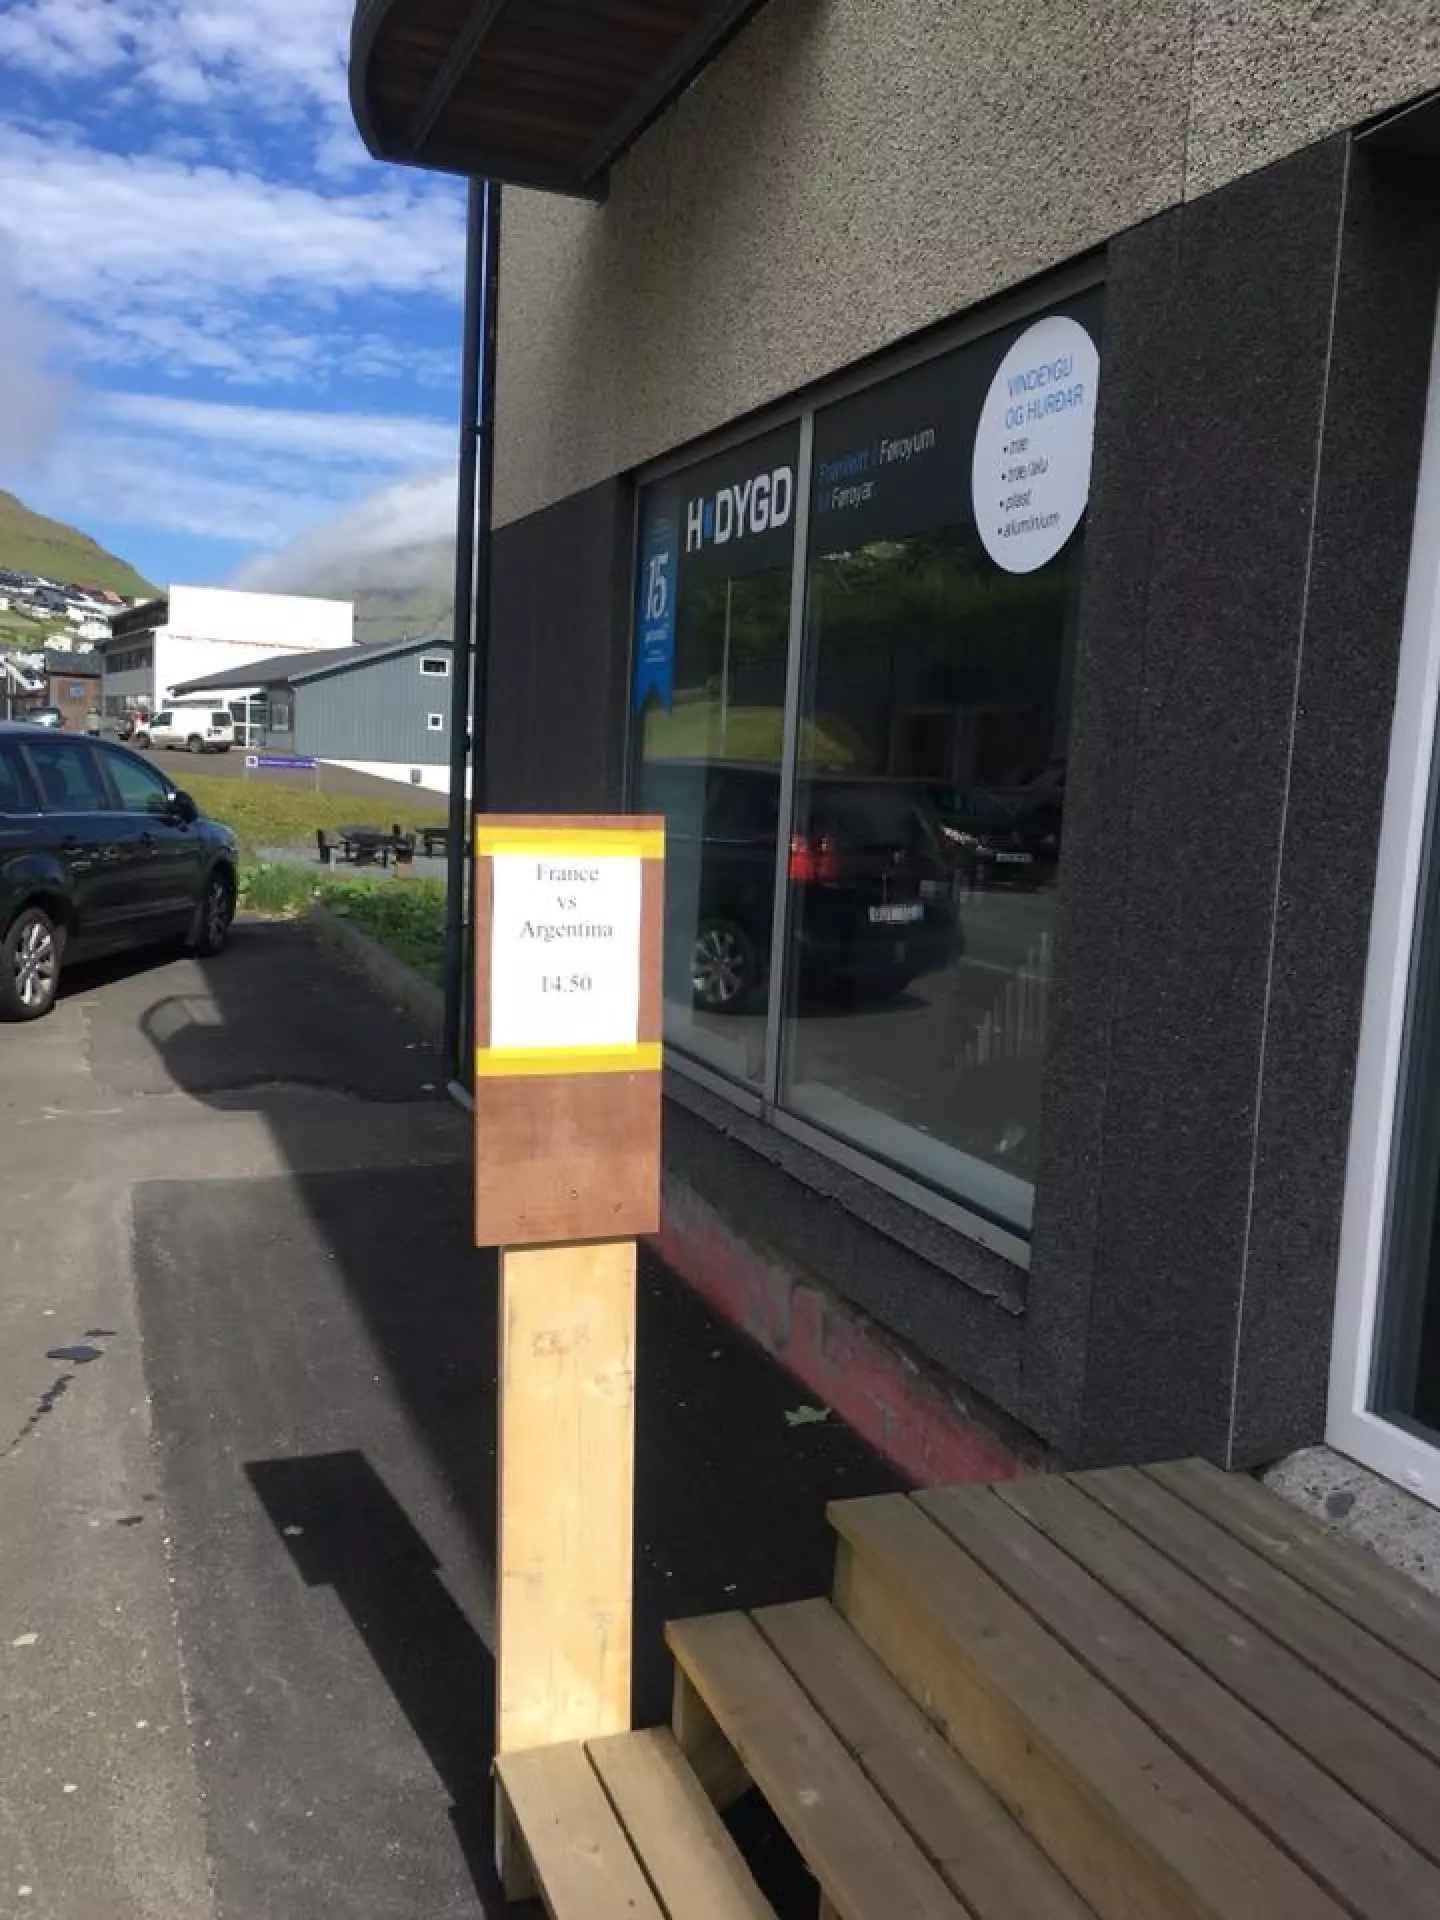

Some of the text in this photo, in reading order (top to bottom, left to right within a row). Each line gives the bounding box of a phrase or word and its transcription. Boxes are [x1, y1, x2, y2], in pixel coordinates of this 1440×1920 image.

[1005, 404, 1025, 429] OG
[537, 863, 600, 882] France
[557, 896, 577, 910] vs
[520, 920, 613, 942] Argentina
[541, 974, 593, 993] 14.50
